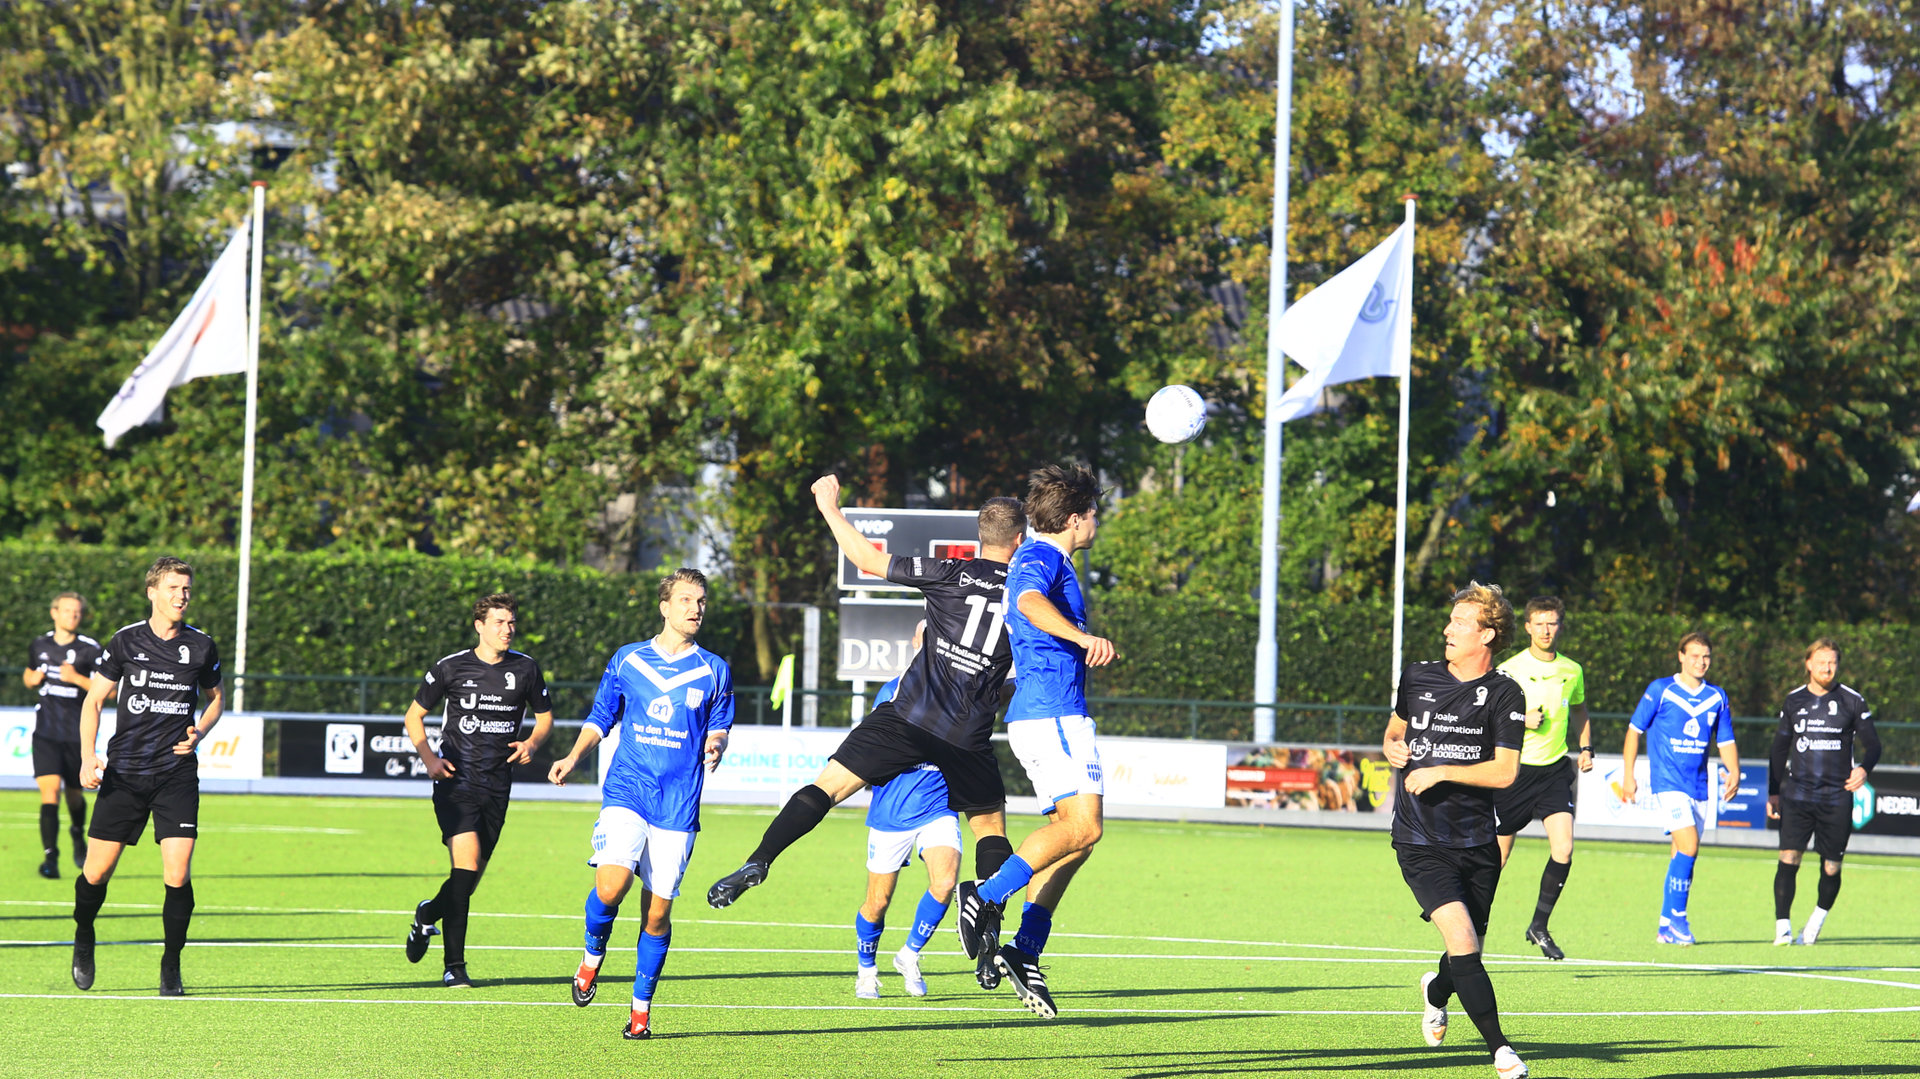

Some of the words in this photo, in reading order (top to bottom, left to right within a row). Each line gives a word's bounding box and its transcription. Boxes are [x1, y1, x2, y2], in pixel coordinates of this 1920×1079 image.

[960, 594, 1004, 657] 11
[149, 671, 175, 681] Joalpe
[479, 693, 503, 703] Joalpe
[1433, 712, 1459, 724] Joalpe
[645, 723, 662, 736] den
[1431, 723, 1484, 736] International
[1432, 742, 1482, 754] LANDGOED
[1431, 750, 1481, 760] ROODSELAAR
